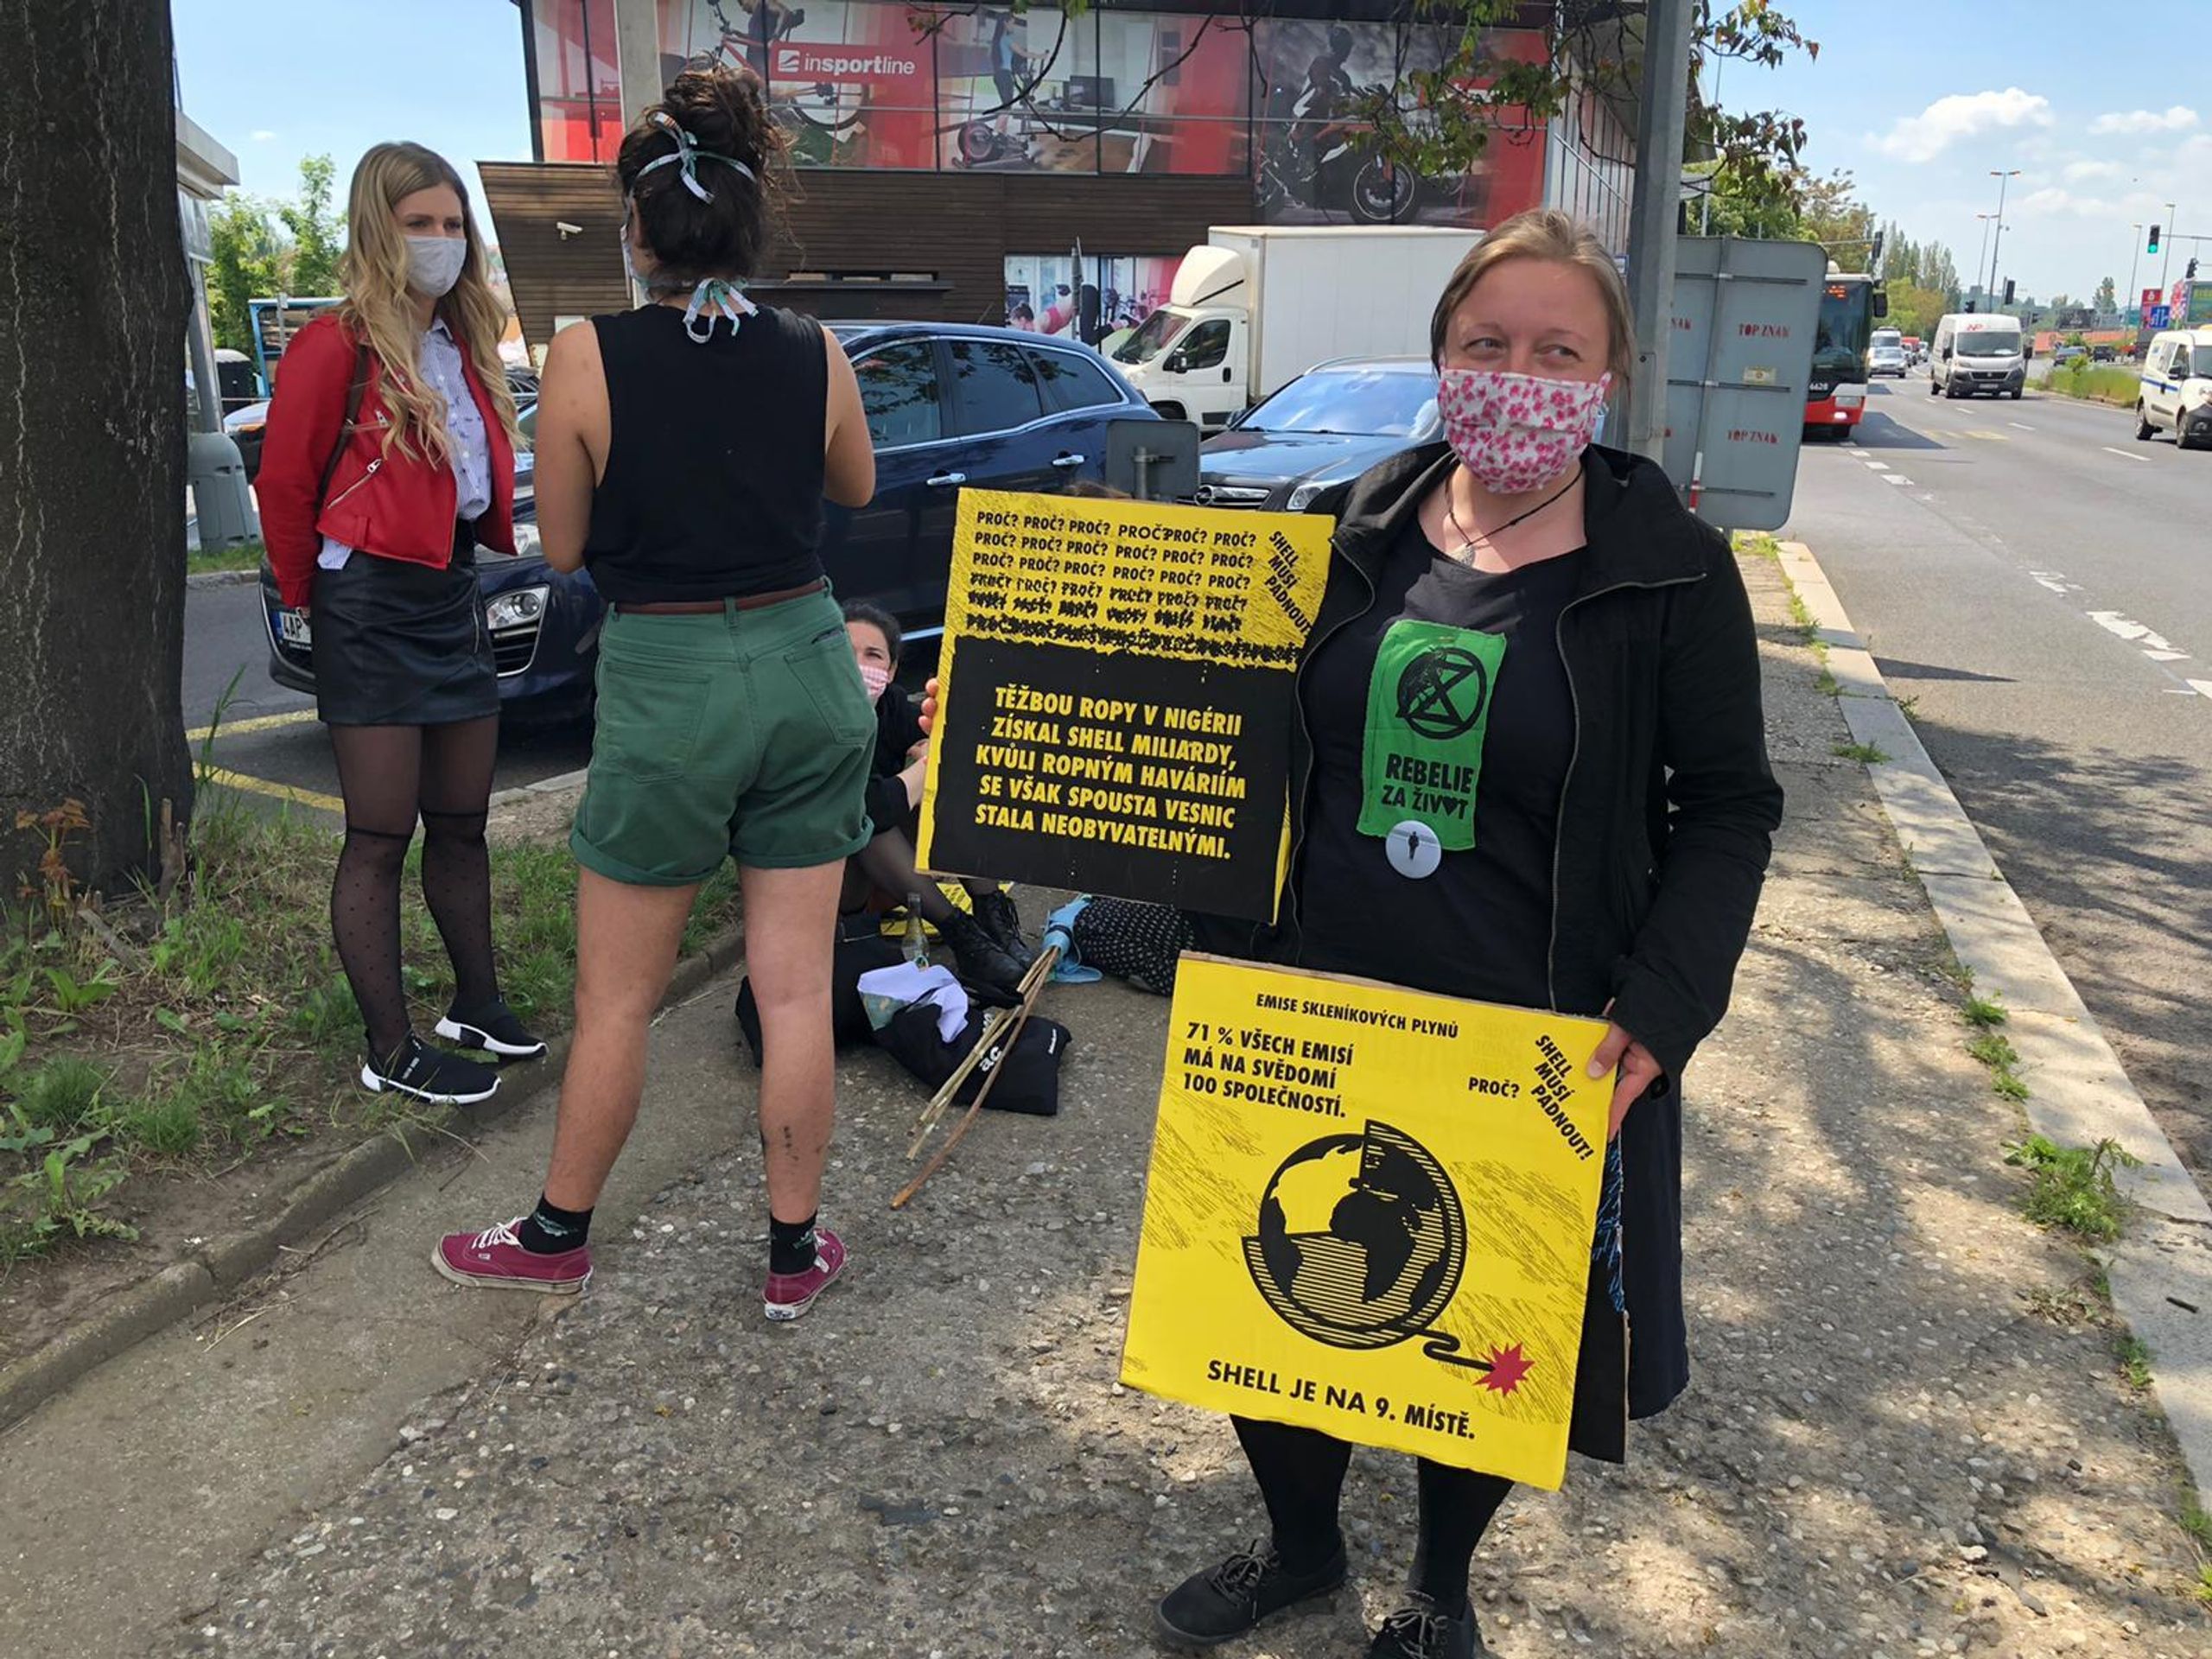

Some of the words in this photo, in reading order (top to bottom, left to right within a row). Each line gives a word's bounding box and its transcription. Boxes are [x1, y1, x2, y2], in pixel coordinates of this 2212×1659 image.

[804, 53, 915, 76] insportline
[975, 531, 1017, 547] PROČ?
[1021, 535, 1063, 552] PROČ?
[1066, 540, 1109, 556] PROČ?
[1115, 544, 1157, 561] PROČ?
[1162, 549, 1205, 565] PROČ?
[1211, 552, 1254, 569] PROČ?
[976, 511, 1019, 526] PROČ?
[1024, 514, 1065, 531] PROČ?
[1069, 519, 1110, 535] PROČ?
[1166, 527, 1207, 543] PROČ?
[1214, 531, 1256, 547] PROČ?
[1268, 531, 1299, 568] SHELL
[972, 551, 1014, 568] PROČ?
[1019, 556, 1060, 572] PROČ?
[1064, 561, 1106, 577] PROČ?
[1113, 565, 1154, 582] PROČ?
[1160, 569, 1202, 586] PROČ?
[1208, 573, 1251, 590] PROČ?
[1268, 555, 1301, 589] MUSÍ
[995, 683, 1073, 716] TĚŽBOU
[1079, 696, 1138, 724] ROPY
[1144, 705, 1159, 726] V
[1164, 706, 1243, 736] NIGÉRII
[991, 713, 1060, 745] ZÍSKAL
[1067, 726, 1123, 753] SHELL
[1131, 734, 1236, 771] MILIARDY,
[975, 741, 1036, 771] KVŮLI
[1042, 753, 1133, 784] ROPNÝM
[1141, 766, 1246, 799] HAVÁRIÍM
[1385, 753, 1474, 795] REBELIE
[979, 774, 1002, 797] SE
[1008, 774, 1061, 804] VŠAK
[1068, 786, 1157, 817] SPOUSTA
[1166, 798, 1236, 830] VESNIC
[1381, 784, 1406, 808] ZA
[975, 804, 1034, 830] STALA
[1041, 812, 1230, 860] NEOBYVATELNÝMI.
[1256, 994, 1298, 1012] EMISE
[1302, 1001, 1406, 1030] SKLENÍKOVÝCH
[1411, 1018, 1459, 1039] PLYNŮ
[1187, 1021, 1209, 1041] 71
[1217, 1027, 1233, 1045] %
[1240, 1028, 1295, 1055] VŠECH
[1301, 1040, 1354, 1065] EMISÍ
[1535, 1035, 1573, 1077] SHELL
[1184, 1046, 1214, 1068] MÁ
[1220, 1053, 1245, 1073] NA
[1252, 1058, 1337, 1090] SVĚDOMÍ
[1468, 1075, 1520, 1099] PROČ?
[1534, 1062, 1575, 1103] MUSÍ
[1184, 1072, 1217, 1094] 100
[1223, 1080, 1345, 1118] SPOLEČNOSTÍ.
[1530, 1084, 1594, 1160] PADNOUT!
[1207, 1360, 1281, 1395] SHELL
[1289, 1378, 1316, 1402] JE
[1325, 1387, 1366, 1414] NA
[1375, 1397, 1396, 1421] 9.
[1404, 1402, 1476, 1440] MÍSTĚ.
